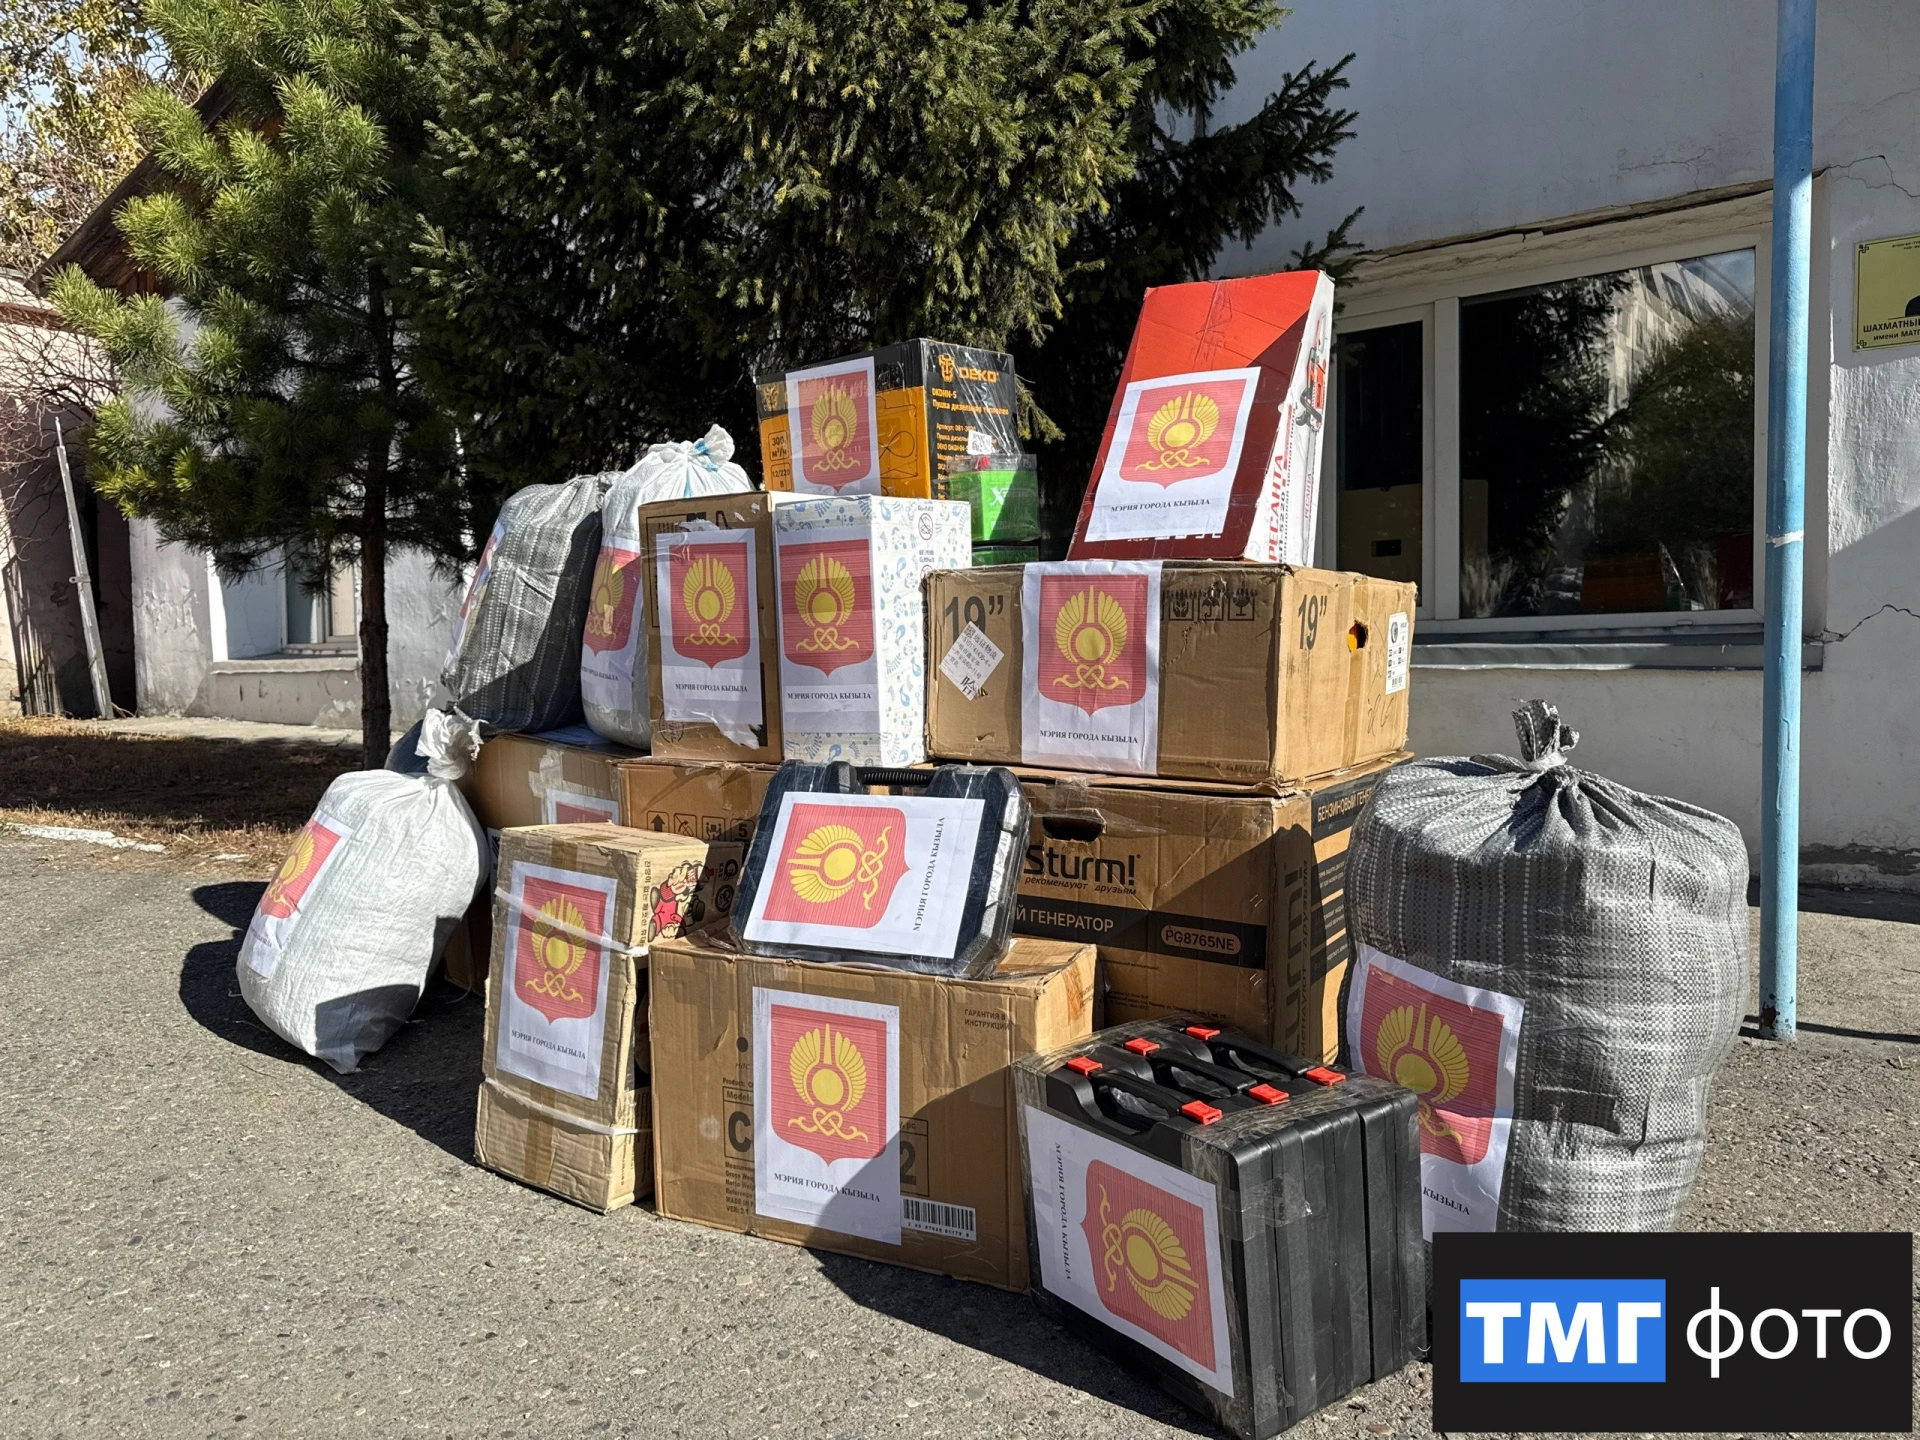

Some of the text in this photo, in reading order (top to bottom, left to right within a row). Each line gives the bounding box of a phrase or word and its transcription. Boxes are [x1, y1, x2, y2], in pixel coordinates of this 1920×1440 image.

[1863, 319, 1920, 333] ШАХМАТНЫ
[1873, 333, 1899, 341] имени
[1111, 498, 1210, 512] МЭРИЯ ГОРОДА КЫЗЫЛА
[1268, 455, 1284, 562] РЕСАНТА
[675, 683, 696, 691] МЭРИЯ
[696, 684, 720, 692] ГОРОДА
[787, 692, 872, 700] МЭРИЯ ГОРОДА КЫЗЫЛА
[1039, 730, 1138, 744] МЭРИЯ ГОРОДА КЫЗЫЛА
[737, 823, 748, 838] 5
[913, 817, 945, 931] МЭРИЯ ГОРОДА КЫЗЫЛА
[1023, 844, 1136, 887] Sturm!
[1025, 876, 1137, 896] рекомендуют друзьям
[1030, 909, 1114, 933] ГЕНЕРАТОР
[1165, 929, 1234, 951] PG8765NE
[964, 1008, 1000, 1019] ГАРАНТИЯ
[512, 1029, 586, 1060] МЭРИЯ ГОРОДА КЫЗЫЛА
[726, 1090, 752, 1102] Model:
[774, 1172, 881, 1203] МЭРИЯ ГОРОДА КЫЗЫЛА
[1055, 1142, 1072, 1280] МЭРИЯ ГОРОДА КЫЗЫЛА
[1423, 1186, 1470, 1216] КЫЗЫЛА
